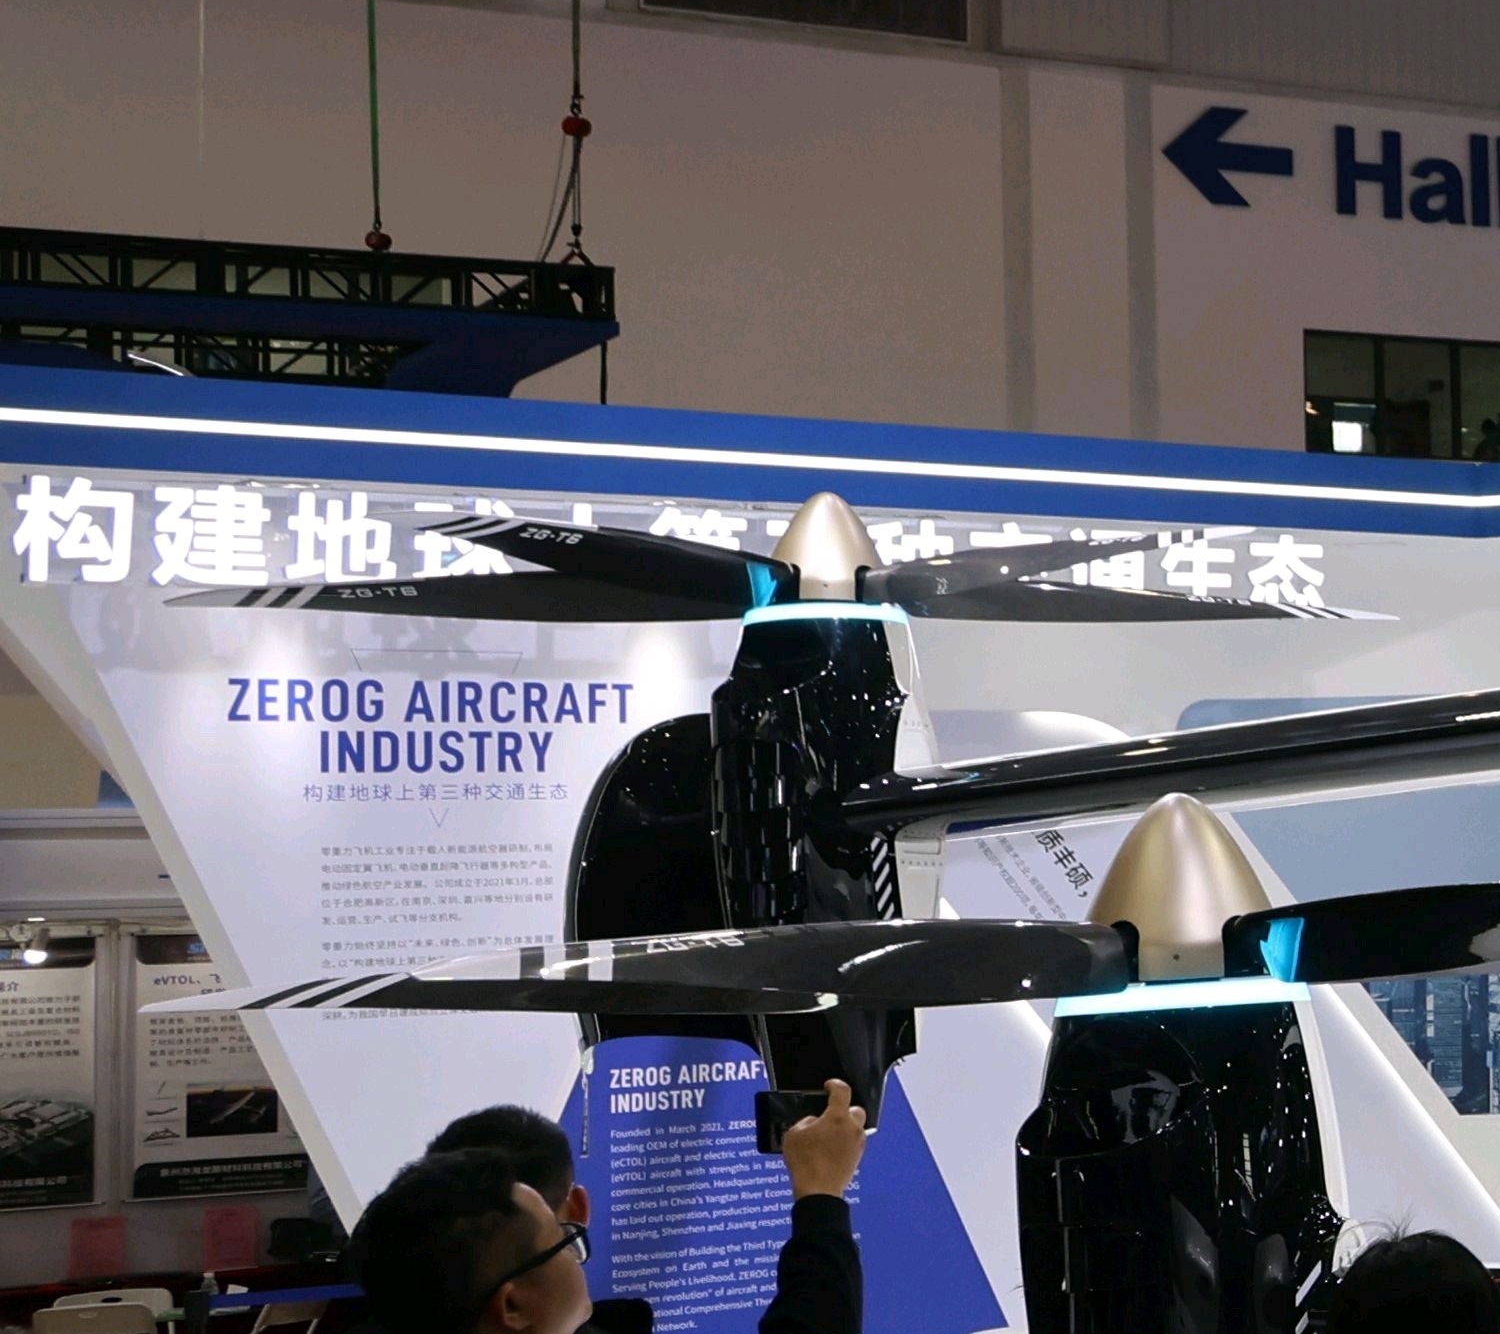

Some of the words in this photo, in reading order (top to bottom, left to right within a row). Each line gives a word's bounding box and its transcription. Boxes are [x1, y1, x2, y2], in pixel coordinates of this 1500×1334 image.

[336, 585, 419, 600] ZG-T6
[228, 678, 385, 723] ZEROG
[404, 681, 635, 725] AIRCRAFT
[319, 730, 554, 774] INDUSTRY
[302, 782, 569, 803] 构建地球上第三种交通生态
[610, 1067, 671, 1089] ZEROG
[610, 1089, 706, 1114] INDUSTRY
[610, 1128, 651, 1140] Founded
[656, 1127, 665, 1136] in
[669, 1124, 697, 1135] March
[610, 1142, 645, 1156] leading
[646, 1138, 668, 1151] OEM
[669, 1137, 679, 1149] of
[681, 1136, 714, 1149] electric
[610, 1153, 647, 1170] (eCTOL)
[649, 1153, 682, 1167] aircraft
[684, 1151, 702, 1163] and
[704, 1149, 736, 1161] electric
[610, 1170, 646, 1185] (eVTOL)
[649, 1168, 682, 1181] aircraft
[685, 1167, 706, 1177] with
[708, 1163, 750, 1177] strengths
[752, 1162, 762, 1170] in
[610, 1183, 665, 1198] commercial
[713, 1174, 780, 1189] Headquartered
[781, 1174, 790, 1182] in
[610, 1202, 631, 1213] core
[633, 1198, 657, 1211] cities
[659, 1198, 669, 1208] in
[670, 1195, 704, 1207] China's
[705, 1191, 740, 1205] Yangtze
[740, 1191, 763, 1202] River
[610, 1216, 629, 1227] has
[629, 1215, 647, 1225] laid
[647, 1213, 664, 1223] out
[712, 1205, 762, 1220] production
[763, 1202, 780, 1213] and
[611, 1231, 621, 1241] in
[622, 1228, 660, 1242] Nanjing,
[661, 1224, 706, 1238] Shenzhen
[706, 1222, 725, 1232] and
[726, 1219, 758, 1231] Jiaxing
[611, 1253, 633, 1265] With
[634, 1252, 649, 1262] the
[650, 1249, 677, 1261] vision
[678, 1248, 688, 1258] of
[688, 1244, 726, 1258] Building
[727, 1242, 742, 1253] the
[743, 1240, 768, 1251] Third
[612, 1265, 660, 1280] Ecosystem
[665, 1265, 678, 1274] on
[682, 1261, 707, 1272] Earth
[712, 1258, 730, 1269] and
[734, 1256, 749, 1267] the
[612, 1280, 648, 1295] Serving
[649, 1276, 687, 1291] People's
[738, 1269, 769, 1281] ZEROG
[714, 1288, 725, 1298] of
[726, 1283, 758, 1296] aircraft
[759, 1282, 777, 1293] and
[684, 1298, 753, 1314] Comprehensive
[657, 1321, 698, 1333] Network.
